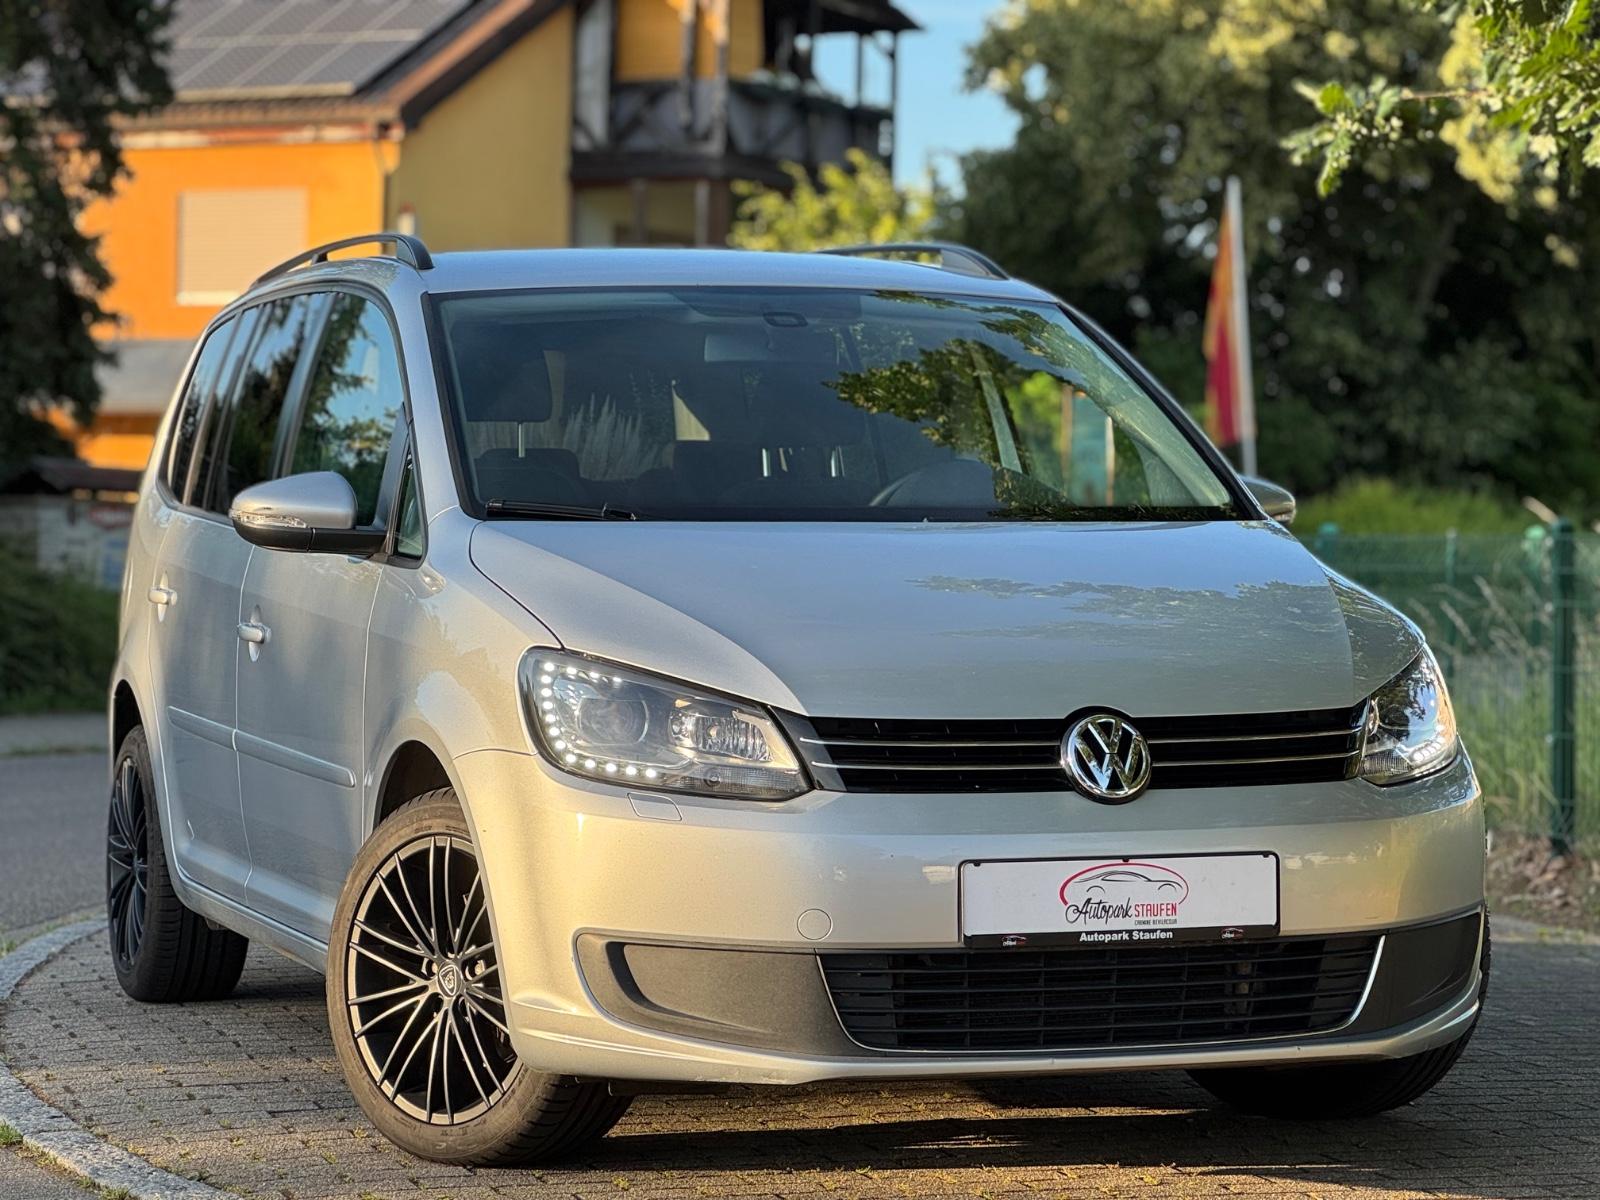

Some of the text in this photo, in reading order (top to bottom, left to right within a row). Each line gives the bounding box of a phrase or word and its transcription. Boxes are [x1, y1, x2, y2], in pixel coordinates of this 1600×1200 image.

[1070, 717, 1144, 795] VW
[1065, 897, 1177, 925] Autopark STAUFEN
[1079, 930, 1173, 943] Autopark Staufen
